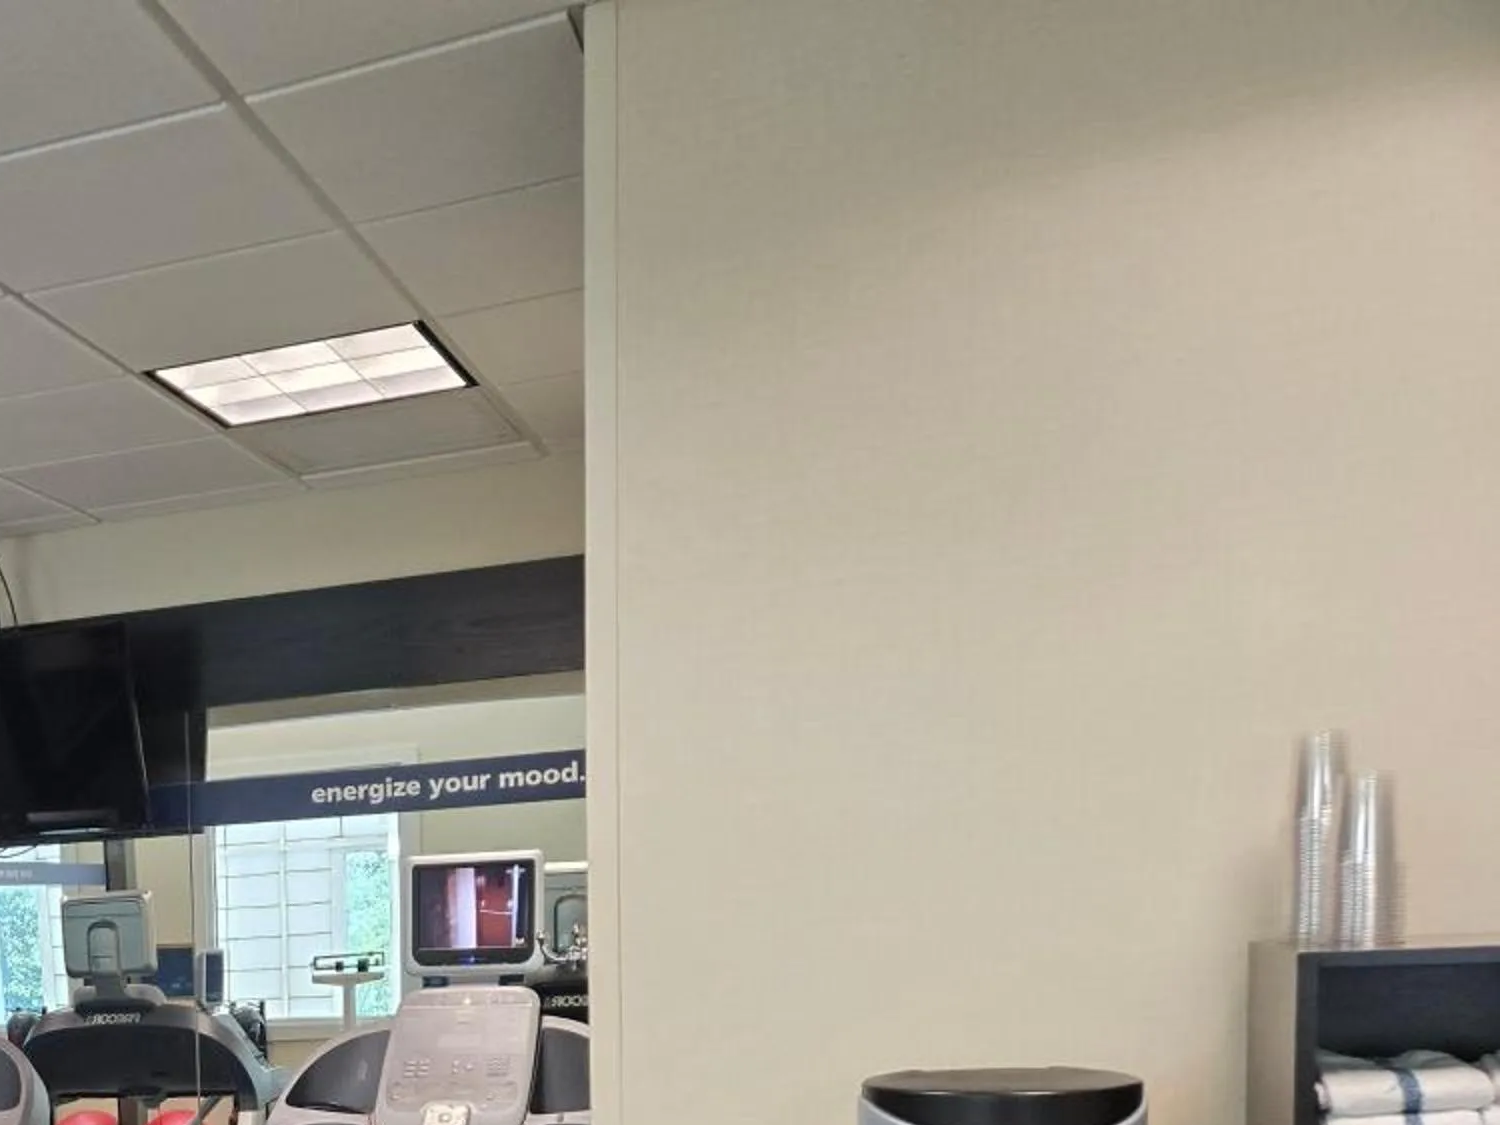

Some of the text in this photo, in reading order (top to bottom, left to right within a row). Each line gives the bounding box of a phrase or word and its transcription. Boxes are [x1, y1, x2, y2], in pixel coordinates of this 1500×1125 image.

[311, 760, 586, 804] energize your mood.
